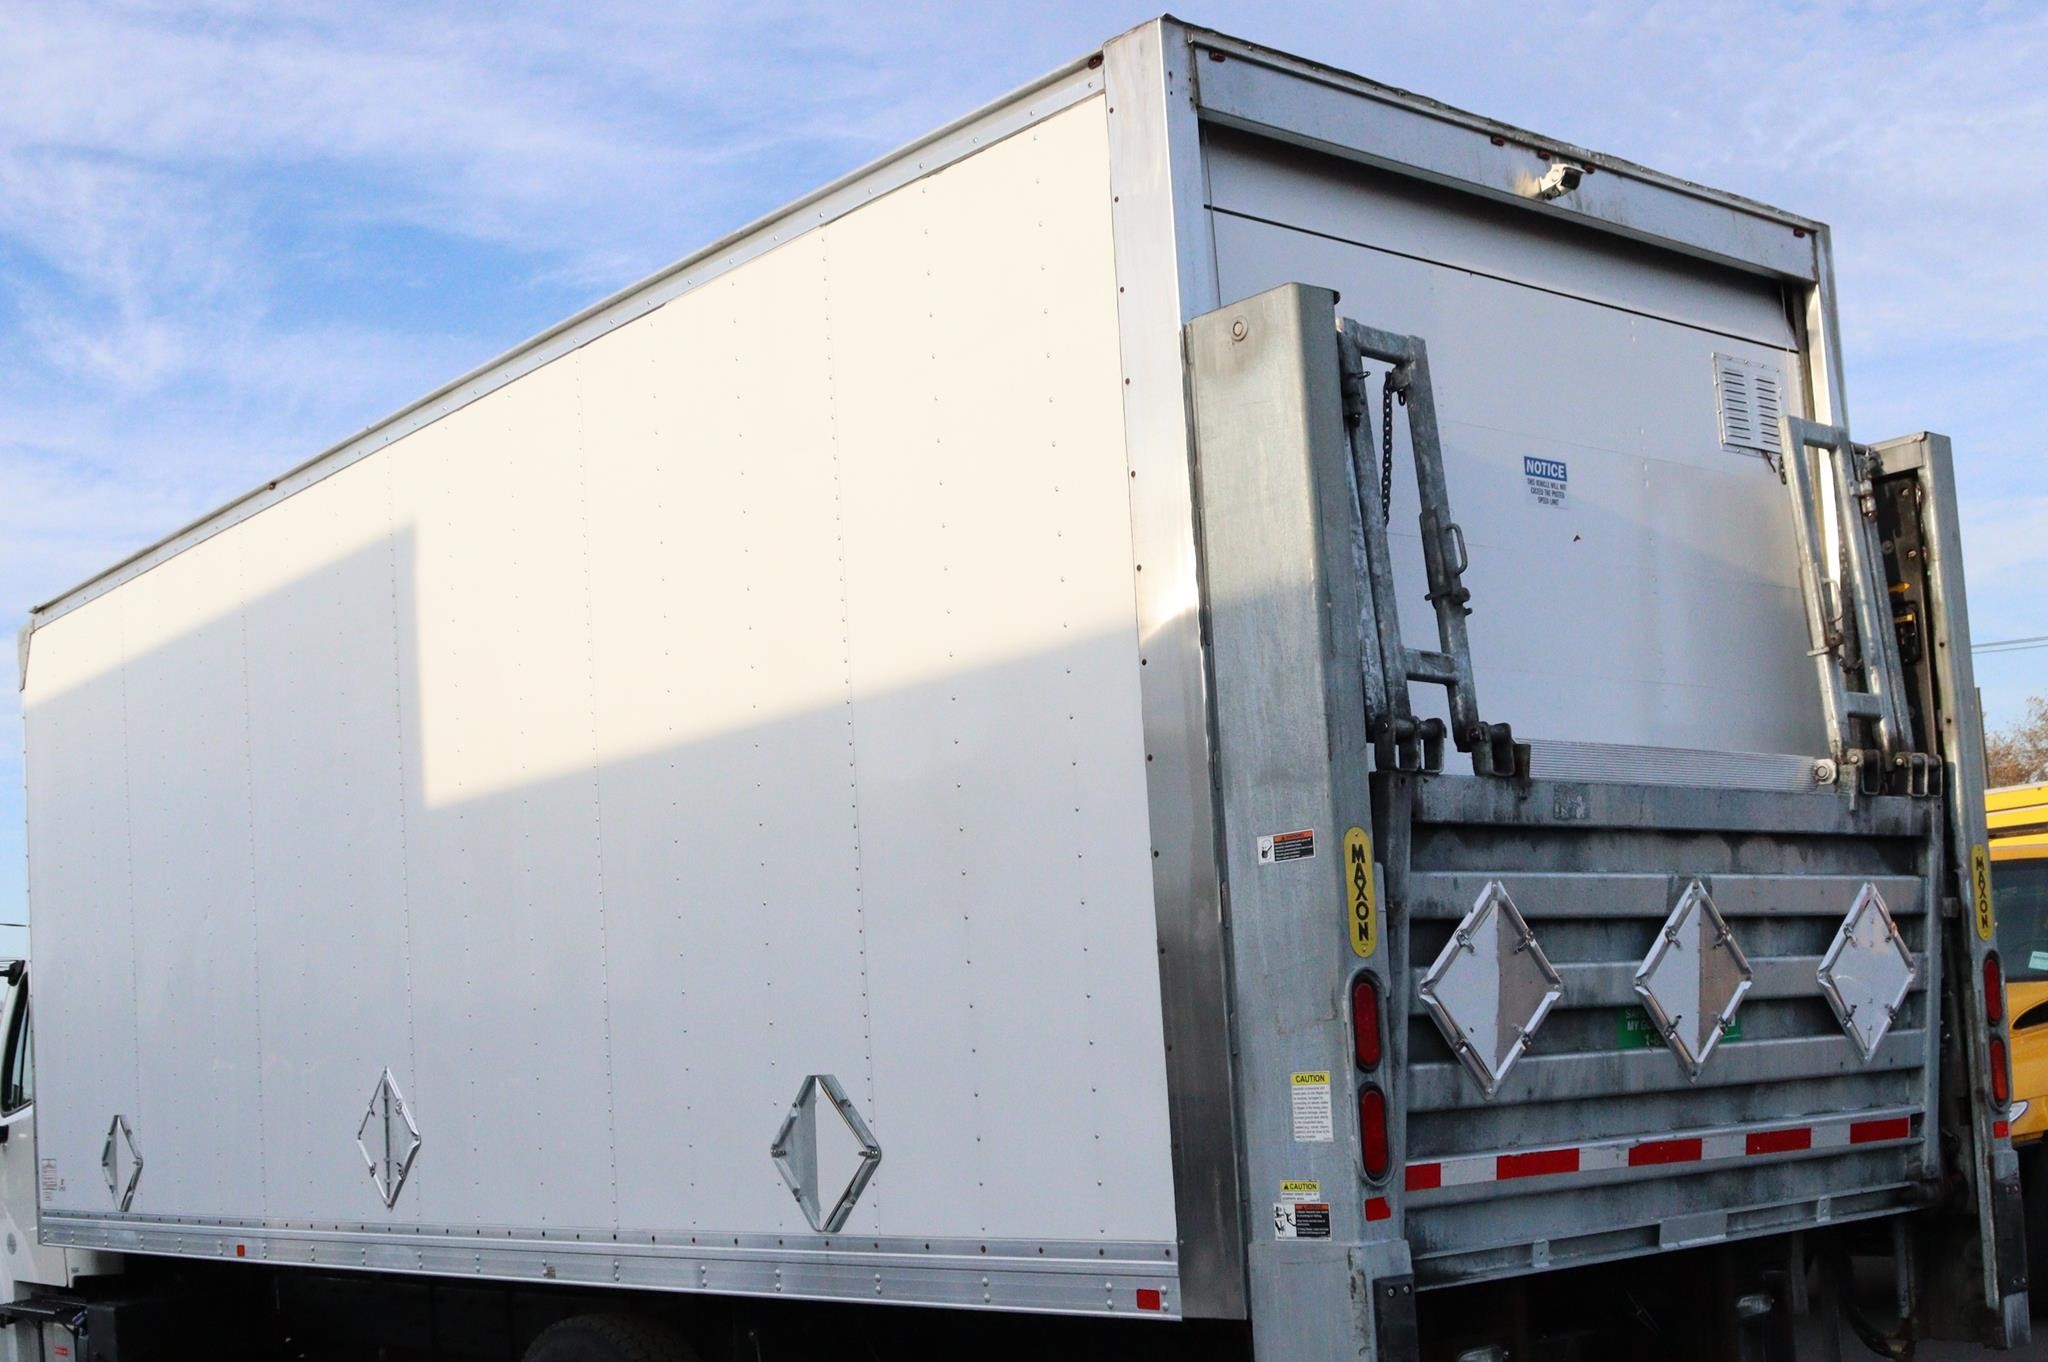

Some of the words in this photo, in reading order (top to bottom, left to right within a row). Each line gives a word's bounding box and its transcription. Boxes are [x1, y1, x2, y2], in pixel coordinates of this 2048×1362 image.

[1526, 459, 1565, 478] NOTICE
[1351, 843, 1370, 942] MAXON
[1976, 856, 1989, 929] MAXON
[1295, 1074, 1326, 1084] CAUTION
[1289, 1183, 1317, 1191] CAUTION
